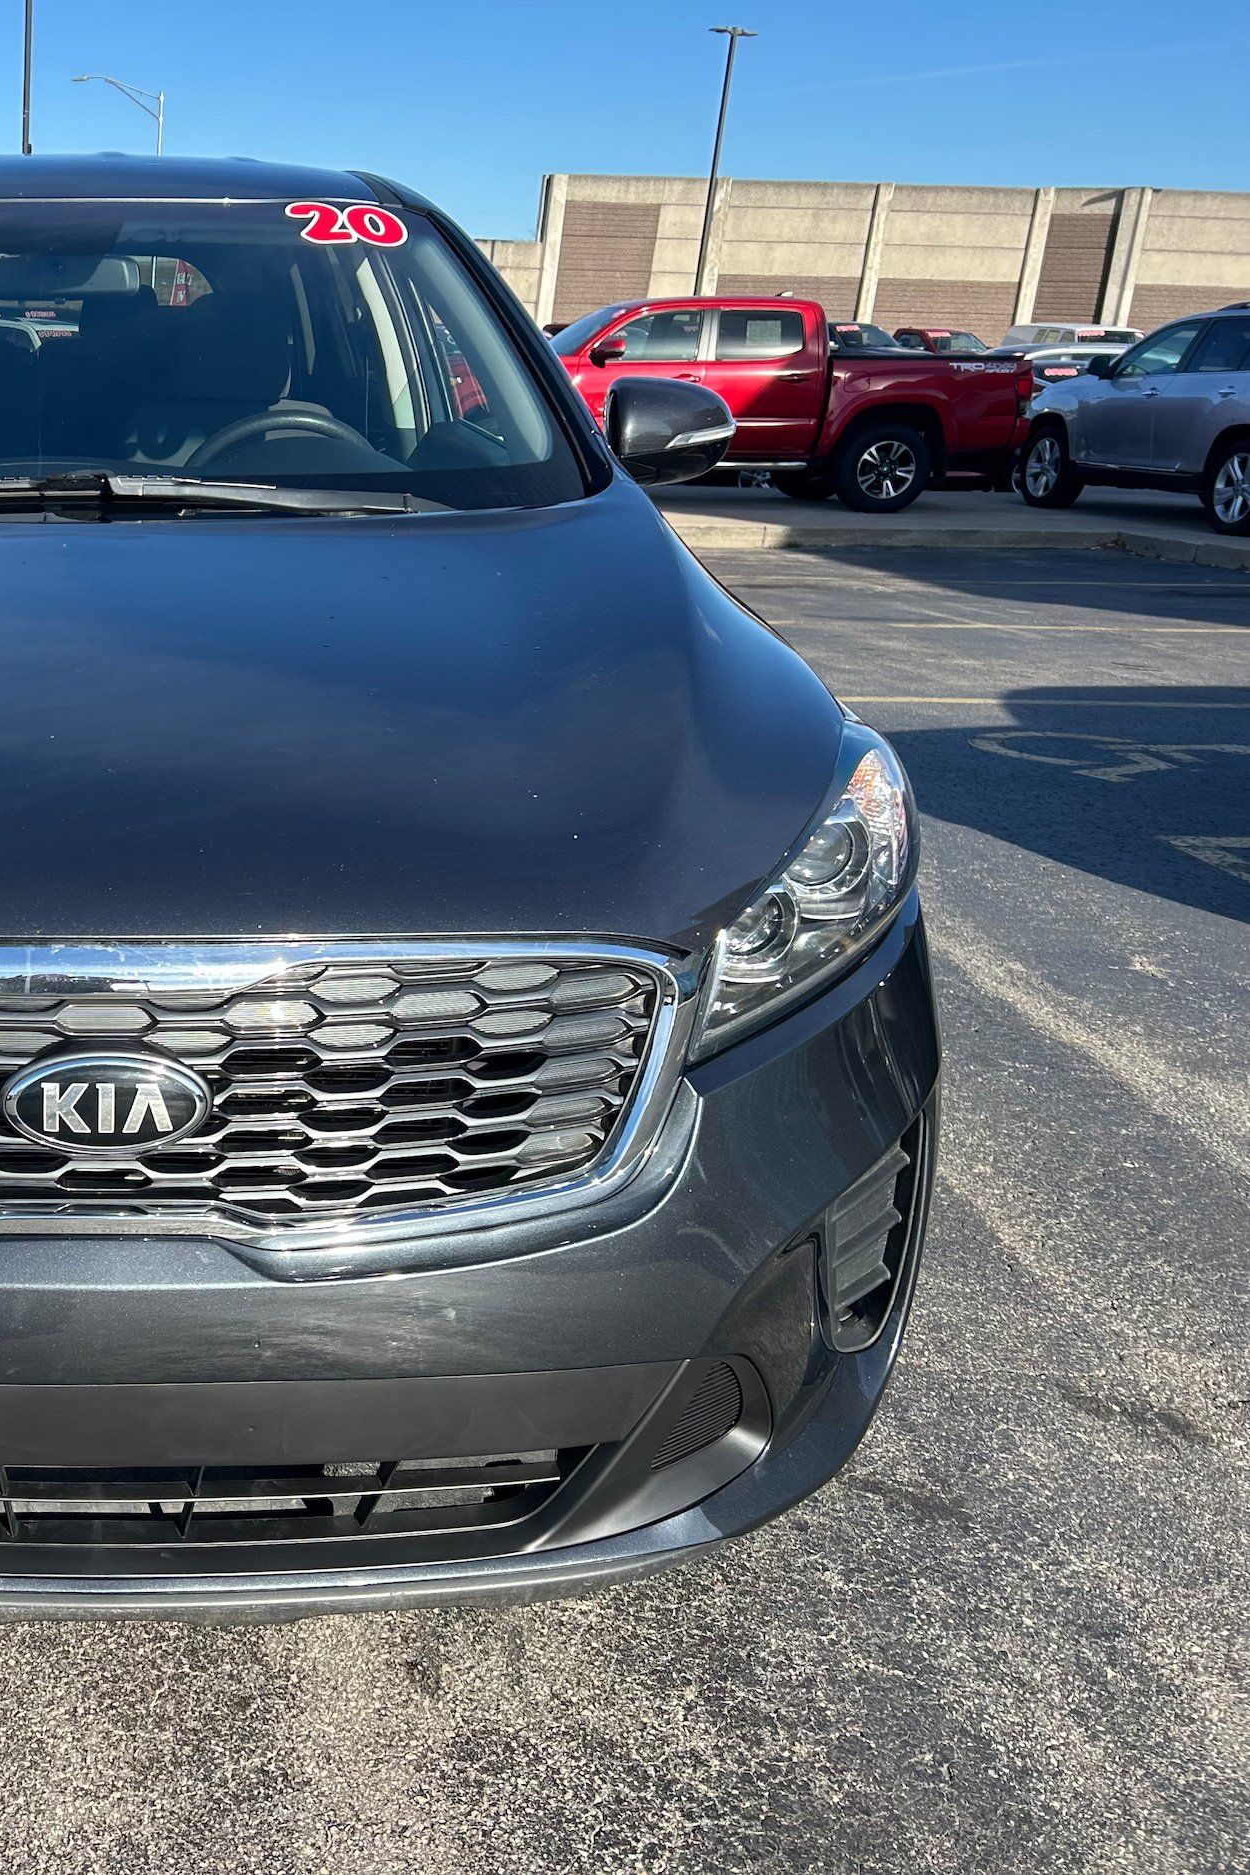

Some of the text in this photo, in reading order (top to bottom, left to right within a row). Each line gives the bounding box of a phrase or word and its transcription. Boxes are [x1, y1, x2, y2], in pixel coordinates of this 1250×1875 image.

[285, 201, 408, 247] 20
[949, 362, 984, 372] TRD
[40, 1082, 174, 1134] KIA
